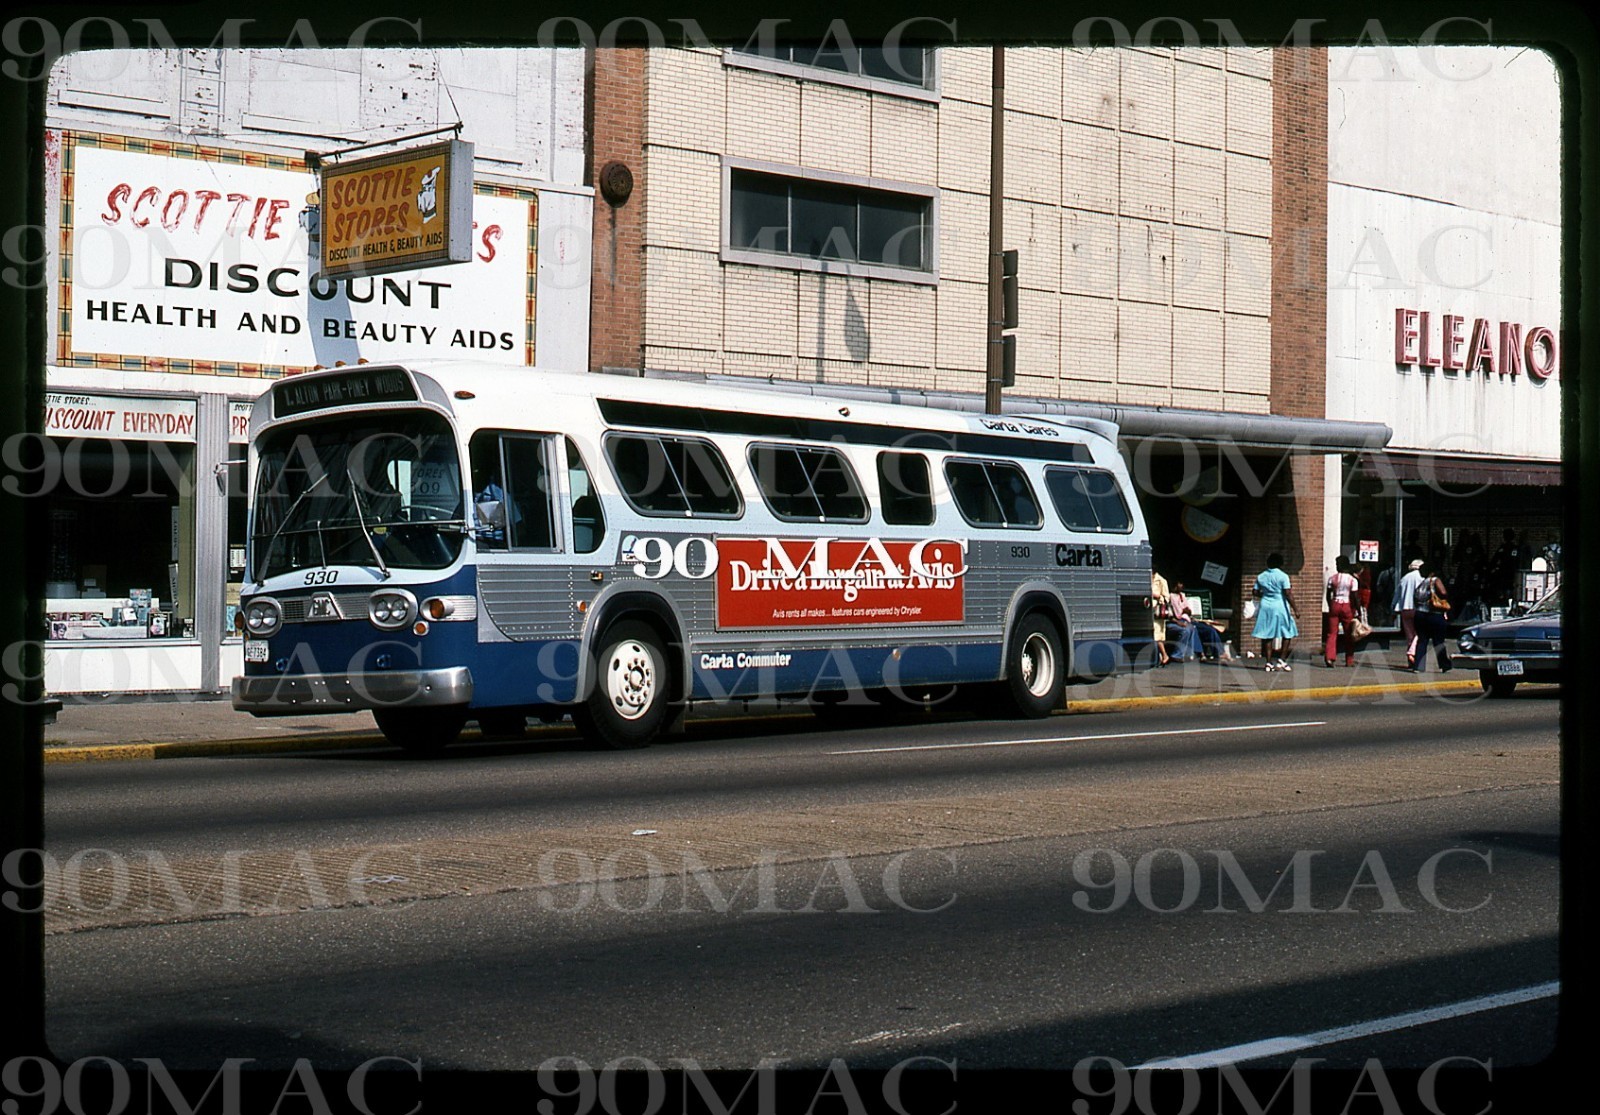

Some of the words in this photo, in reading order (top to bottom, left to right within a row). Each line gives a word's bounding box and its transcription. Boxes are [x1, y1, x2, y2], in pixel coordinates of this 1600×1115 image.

[332, 166, 416, 210] SCOTTIE
[101, 183, 289, 241] SCOTTIE
[332, 202, 410, 243] STORES
[329, 246, 361, 262] DISCOUNT
[363, 241, 388, 256] HEALTH
[389, 240, 396, 254] &
[397, 234, 424, 251] BEAUTY
[425, 232, 443, 247] AIDS
[164, 258, 453, 310] DISCOUNT
[86, 300, 218, 330] HEALTH
[237, 312, 301, 336] AND
[323, 317, 438, 346] BEAUTY
[450, 328, 515, 351] AIDS
[1395, 307, 1557, 380] ELEANO
[45, 407, 115, 431] ISCOUNT
[123, 411, 194, 435] EVERYDAY
[232, 415, 250, 436] PR
[1010, 546, 1030, 558] 930
[1055, 543, 1103, 567] Carta
[304, 570, 339, 586] 930
[729, 559, 794, 591] Drive
[906, 548, 955, 590] Avis
[772, 608, 785, 619] Avis
[785, 608, 800, 618] rents
[831, 607, 852, 617] features
[853, 607, 865, 616] cars
[865, 606, 893, 617] engineered
[893, 606, 901, 617] by
[700, 653, 734, 670] Carta
[736, 651, 792, 668] Commuter
